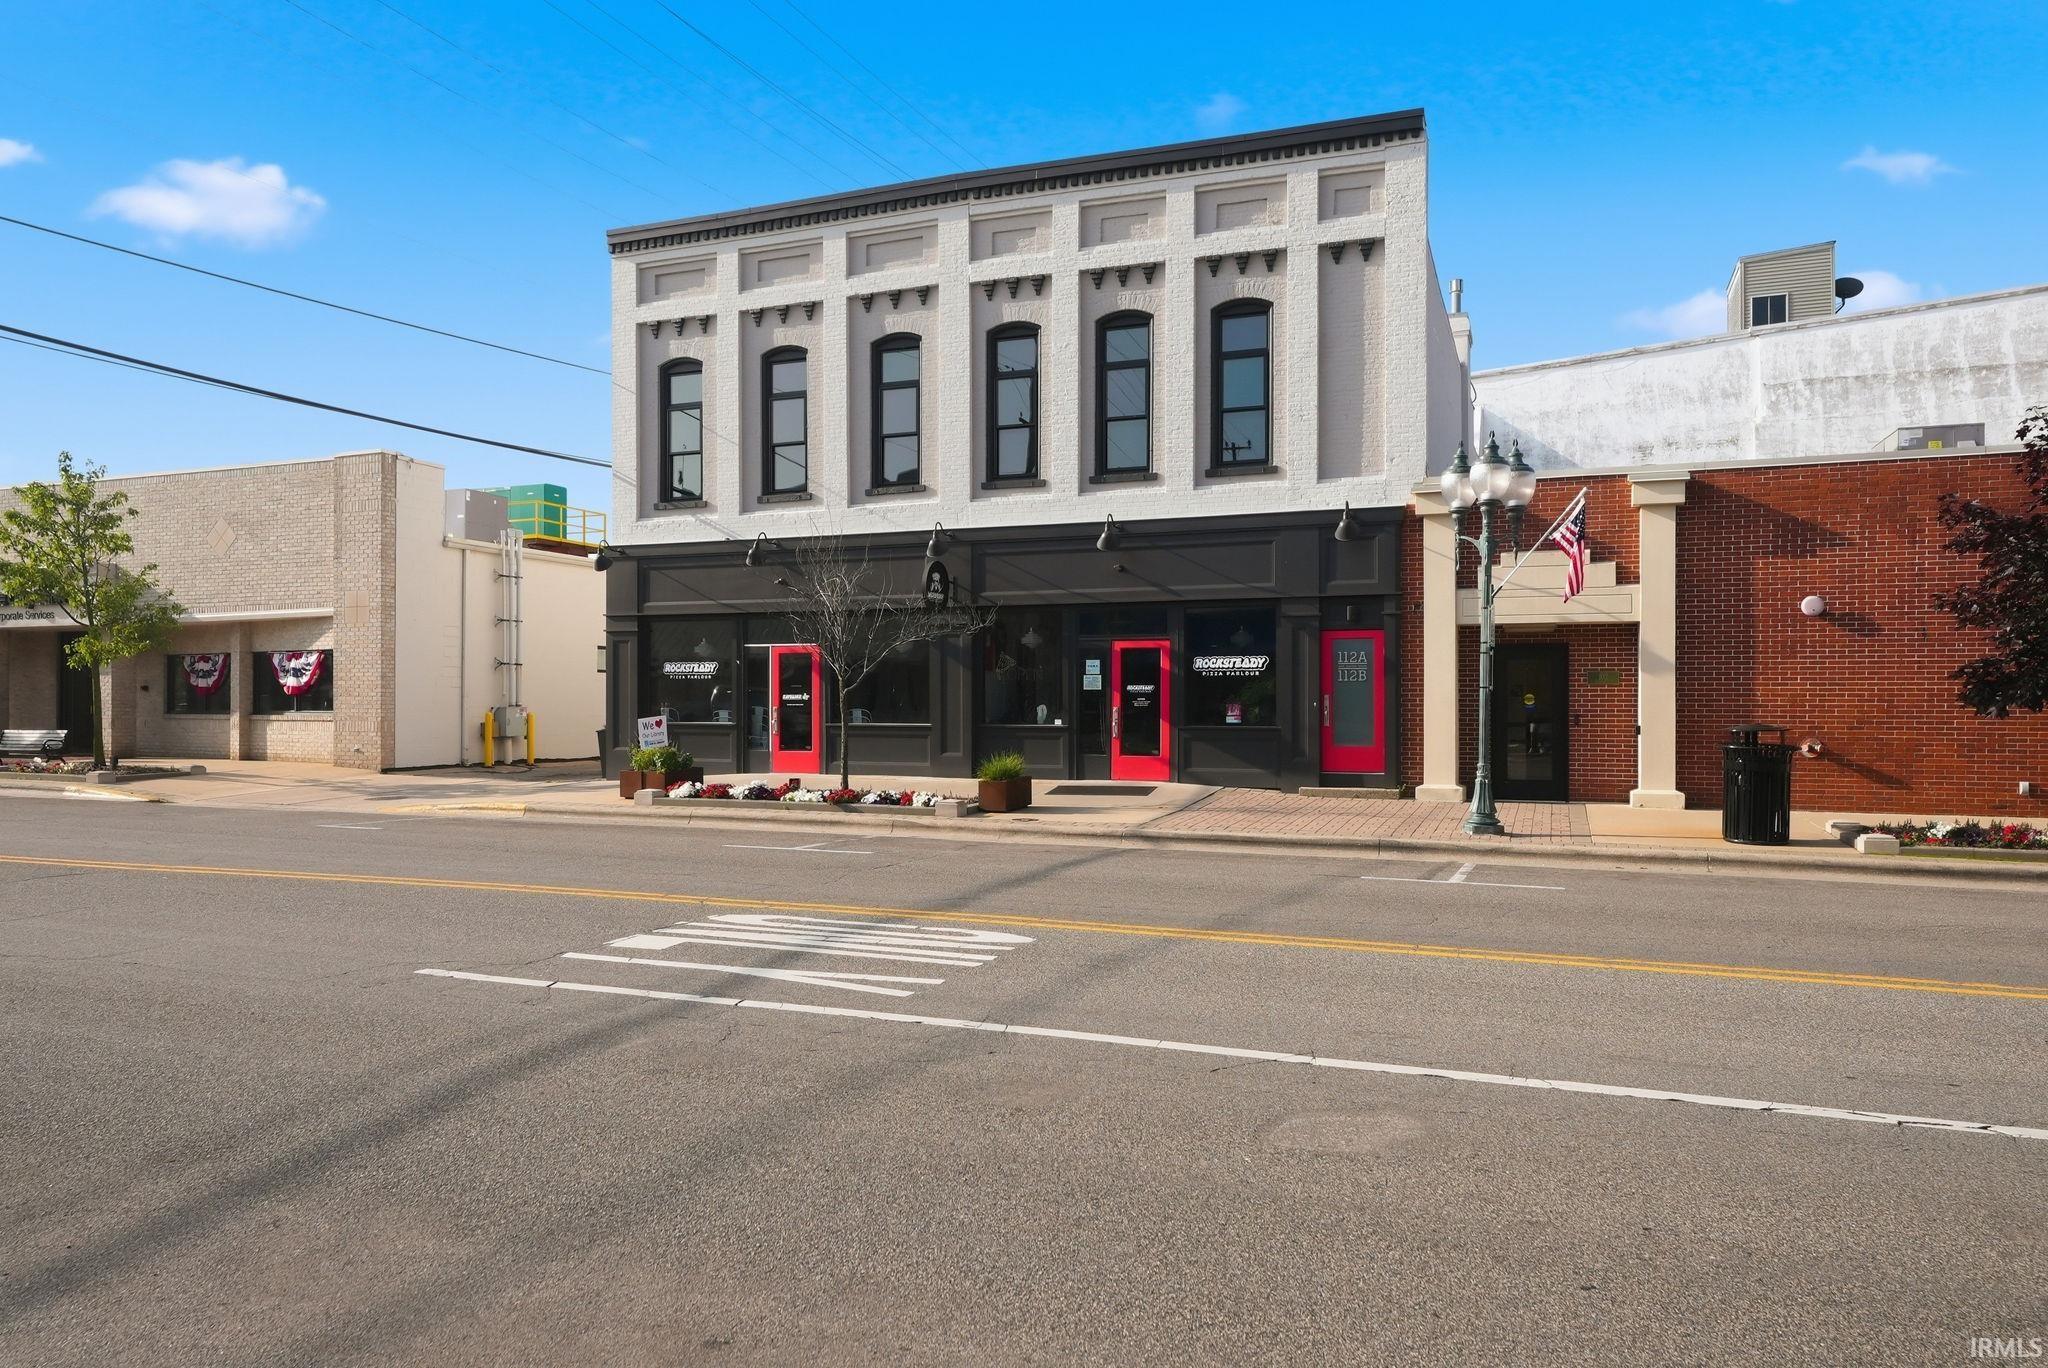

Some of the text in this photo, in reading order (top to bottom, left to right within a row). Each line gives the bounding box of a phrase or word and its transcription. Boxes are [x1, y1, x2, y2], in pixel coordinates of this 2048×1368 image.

[25, 610, 55, 620] Services
[1338, 651, 1367, 663] 112A
[664, 662, 718, 673] ROCKSTEADY
[1194, 657, 1268, 670] ROCKSTEADY
[1338, 669, 1367, 681] 112B
[642, 721, 654, 730] We
[561, 914, 1037, 997] ONLY
